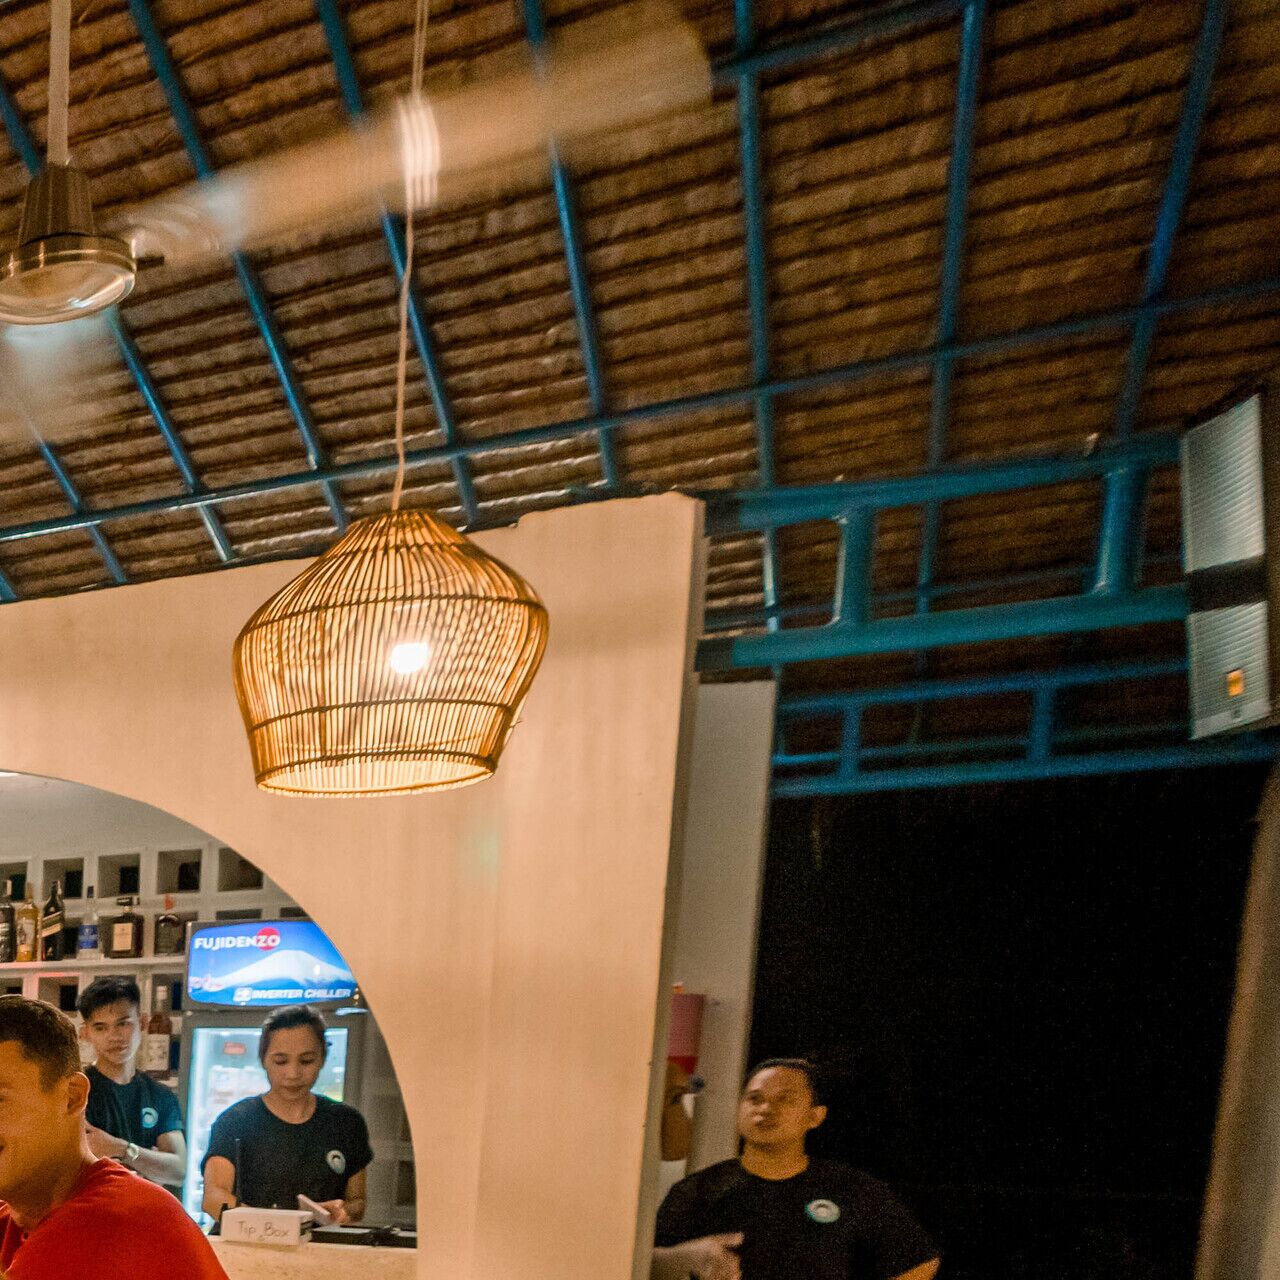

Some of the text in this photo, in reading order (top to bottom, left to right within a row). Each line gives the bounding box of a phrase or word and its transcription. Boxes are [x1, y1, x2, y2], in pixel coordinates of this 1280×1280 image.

[194, 935, 281, 950] FUJIDENZO
[250, 988, 352, 999] INVERTER CHILLER
[238, 1221, 290, 1237] Tip Box
